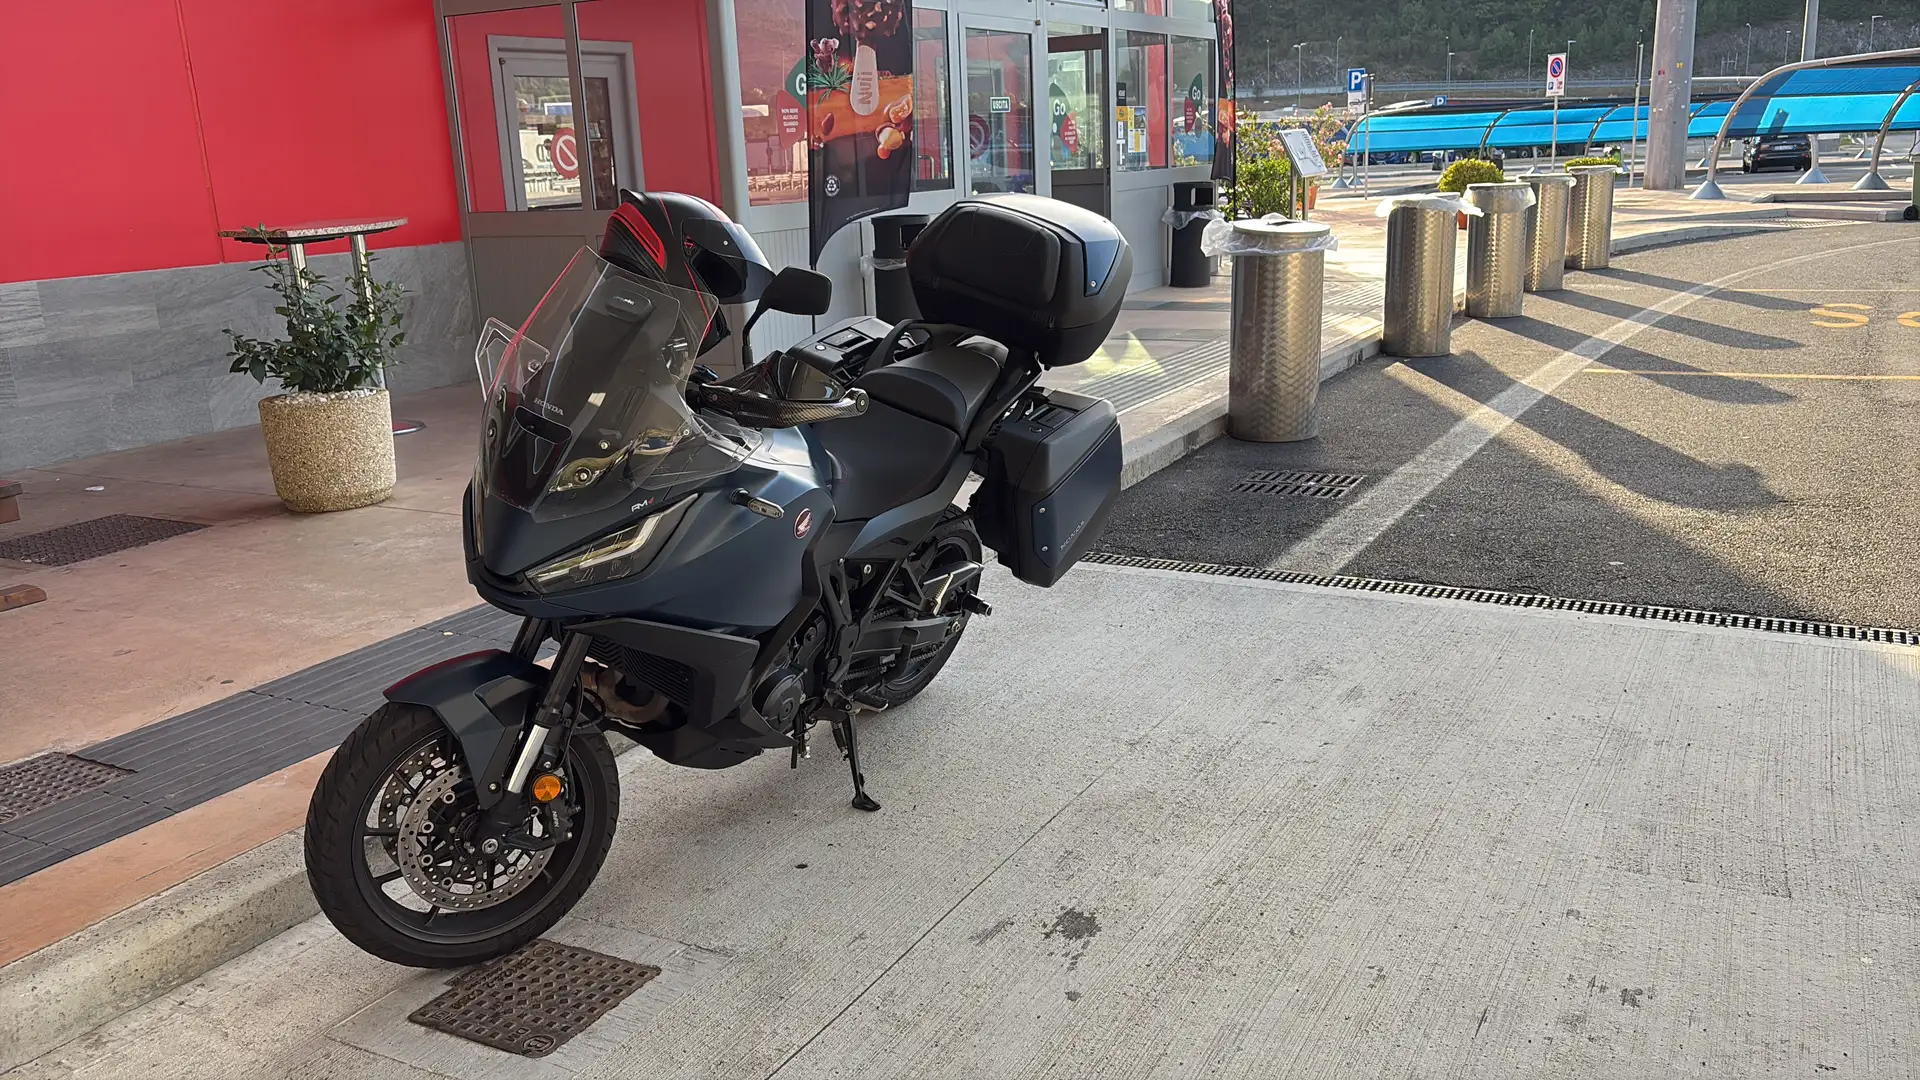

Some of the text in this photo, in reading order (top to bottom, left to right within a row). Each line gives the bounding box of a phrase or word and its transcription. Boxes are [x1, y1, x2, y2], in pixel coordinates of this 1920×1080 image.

[795, 72, 807, 96] G
[1351, 71, 1362, 90] P
[1192, 86, 1201, 101] Go
[992, 100, 1009, 110] USCITA
[1053, 99, 1066, 116] Go
[533, 397, 564, 416] HONDA
